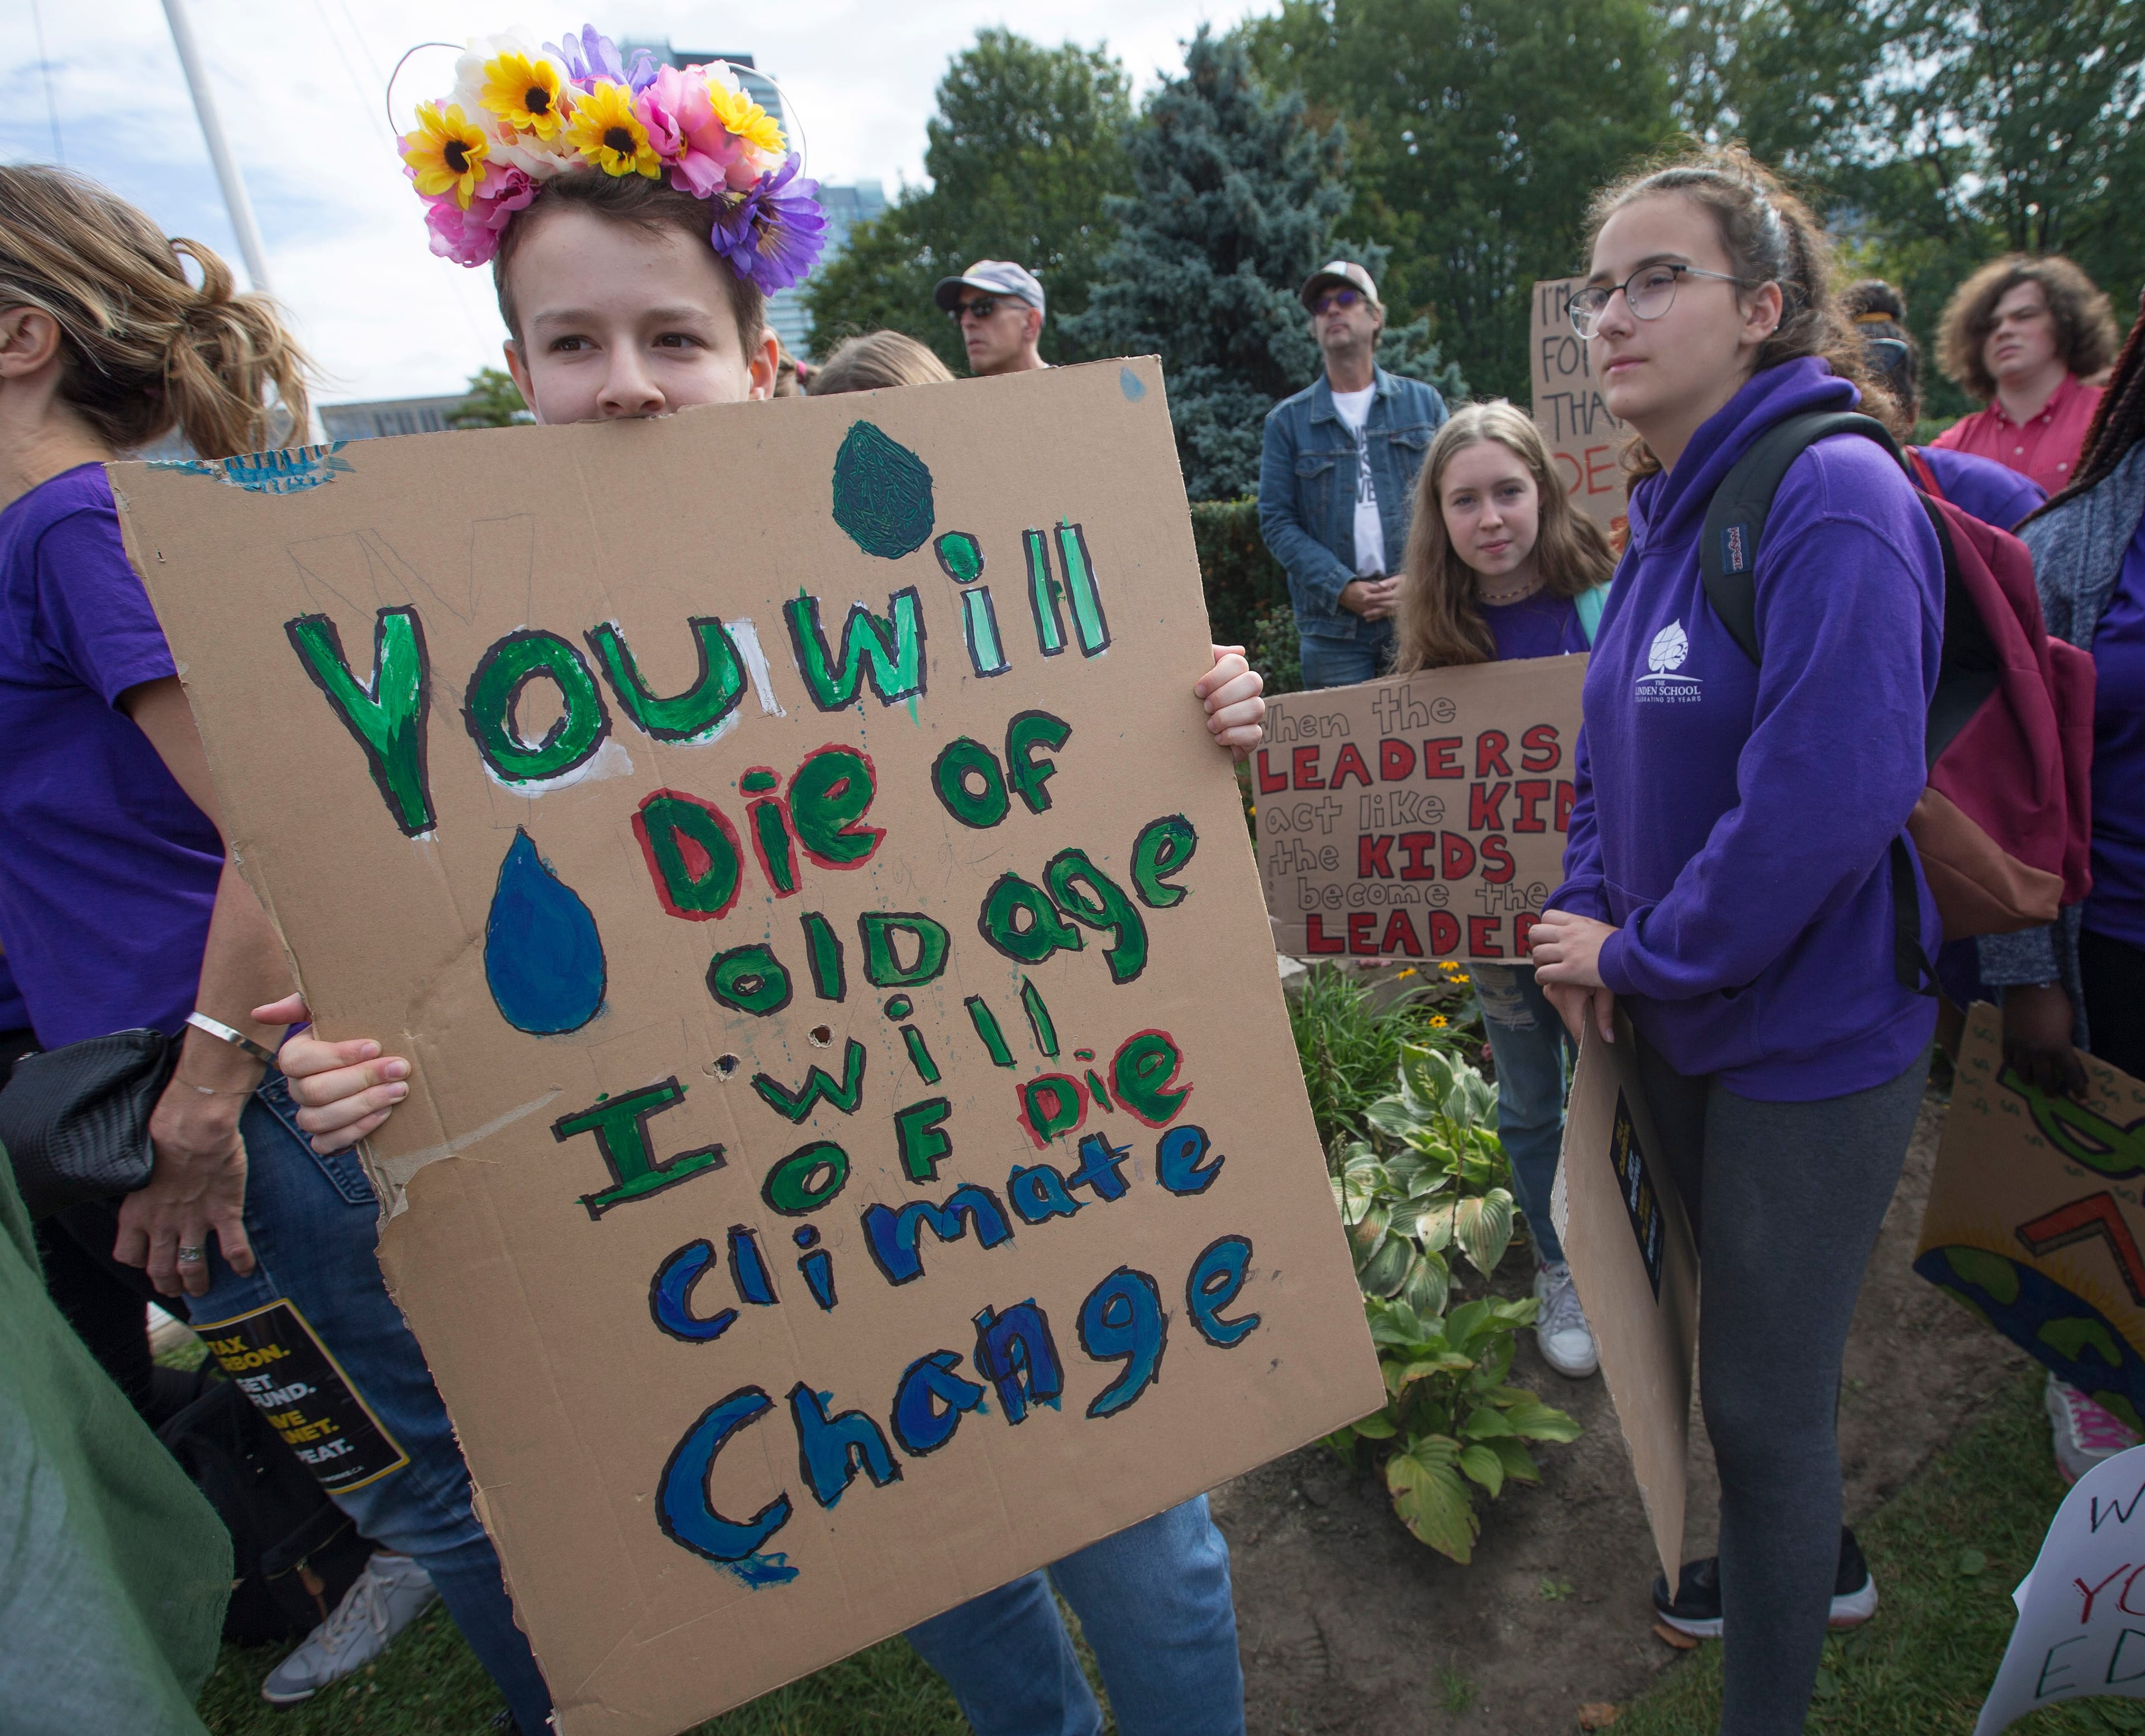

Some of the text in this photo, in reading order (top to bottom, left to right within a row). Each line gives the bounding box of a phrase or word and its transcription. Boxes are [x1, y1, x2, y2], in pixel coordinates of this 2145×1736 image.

[1542, 336, 1589, 383] FO
[1372, 684, 1457, 735] the
[1635, 685, 1701, 696] LINDEN SCHOOL
[931, 709, 1073, 829] of
[1257, 723, 1562, 795] LEADERS
[1265, 795, 1342, 834] act
[1270, 831, 1516, 884] the KIDS
[977, 813, 1199, 985] age
[1297, 876, 1549, 914] become the
[549, 1075, 728, 1222] I
[655, 1234, 1260, 1572] Change
